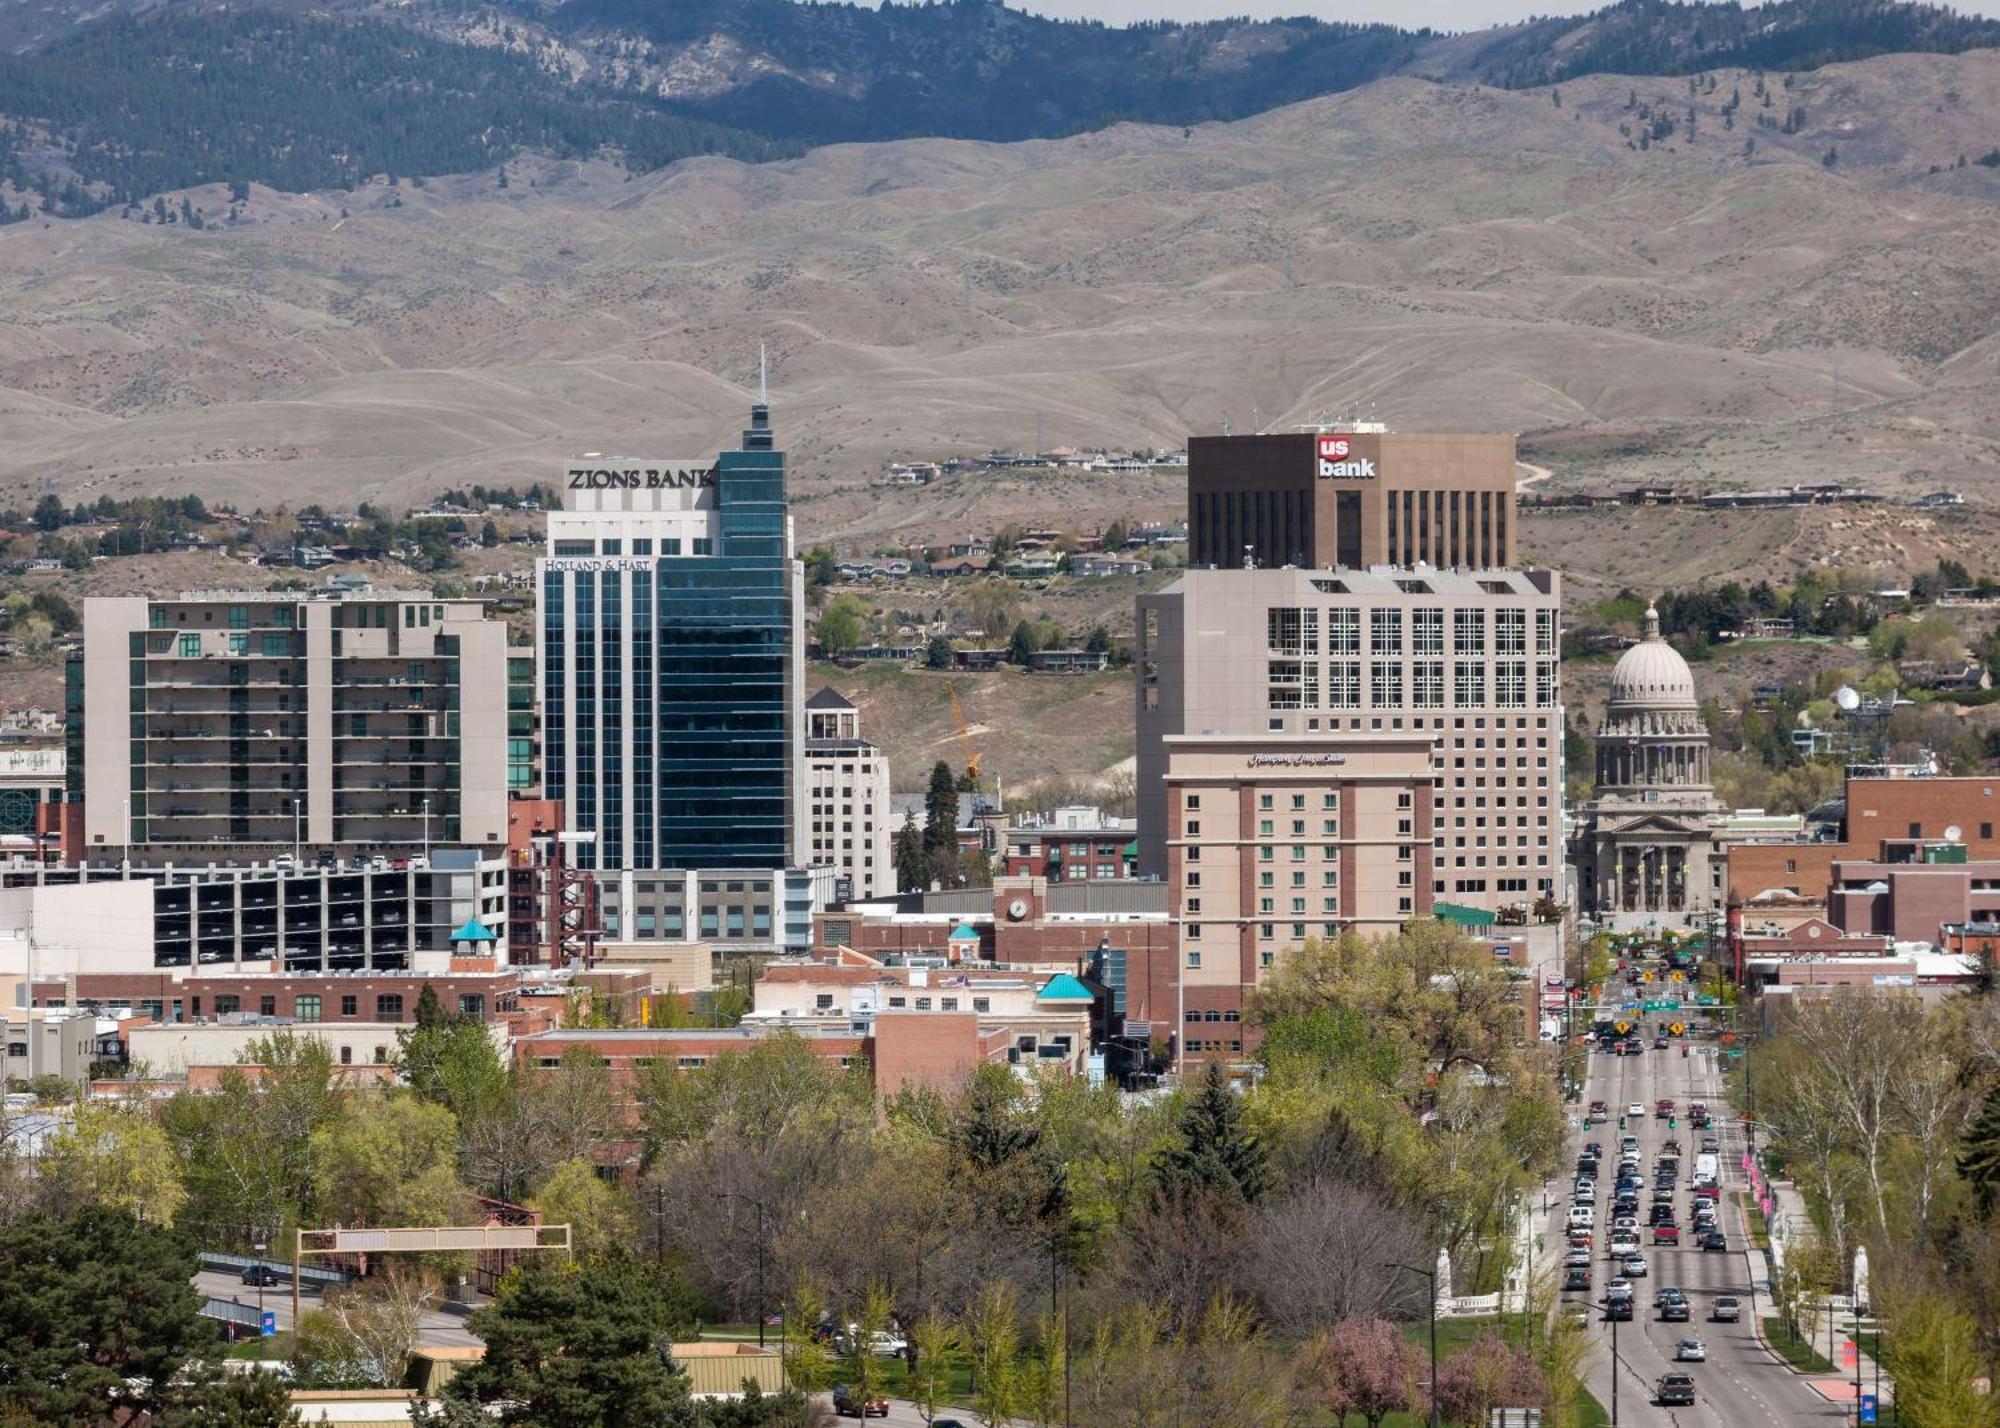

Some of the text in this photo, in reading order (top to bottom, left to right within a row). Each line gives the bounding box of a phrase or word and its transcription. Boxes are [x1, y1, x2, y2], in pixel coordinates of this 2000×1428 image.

[1320, 440, 1349, 455] us
[1319, 458, 1376, 477] bank
[568, 469, 715, 489] ZIONS BANK
[545, 560, 650, 572] HOLLAND & HART
